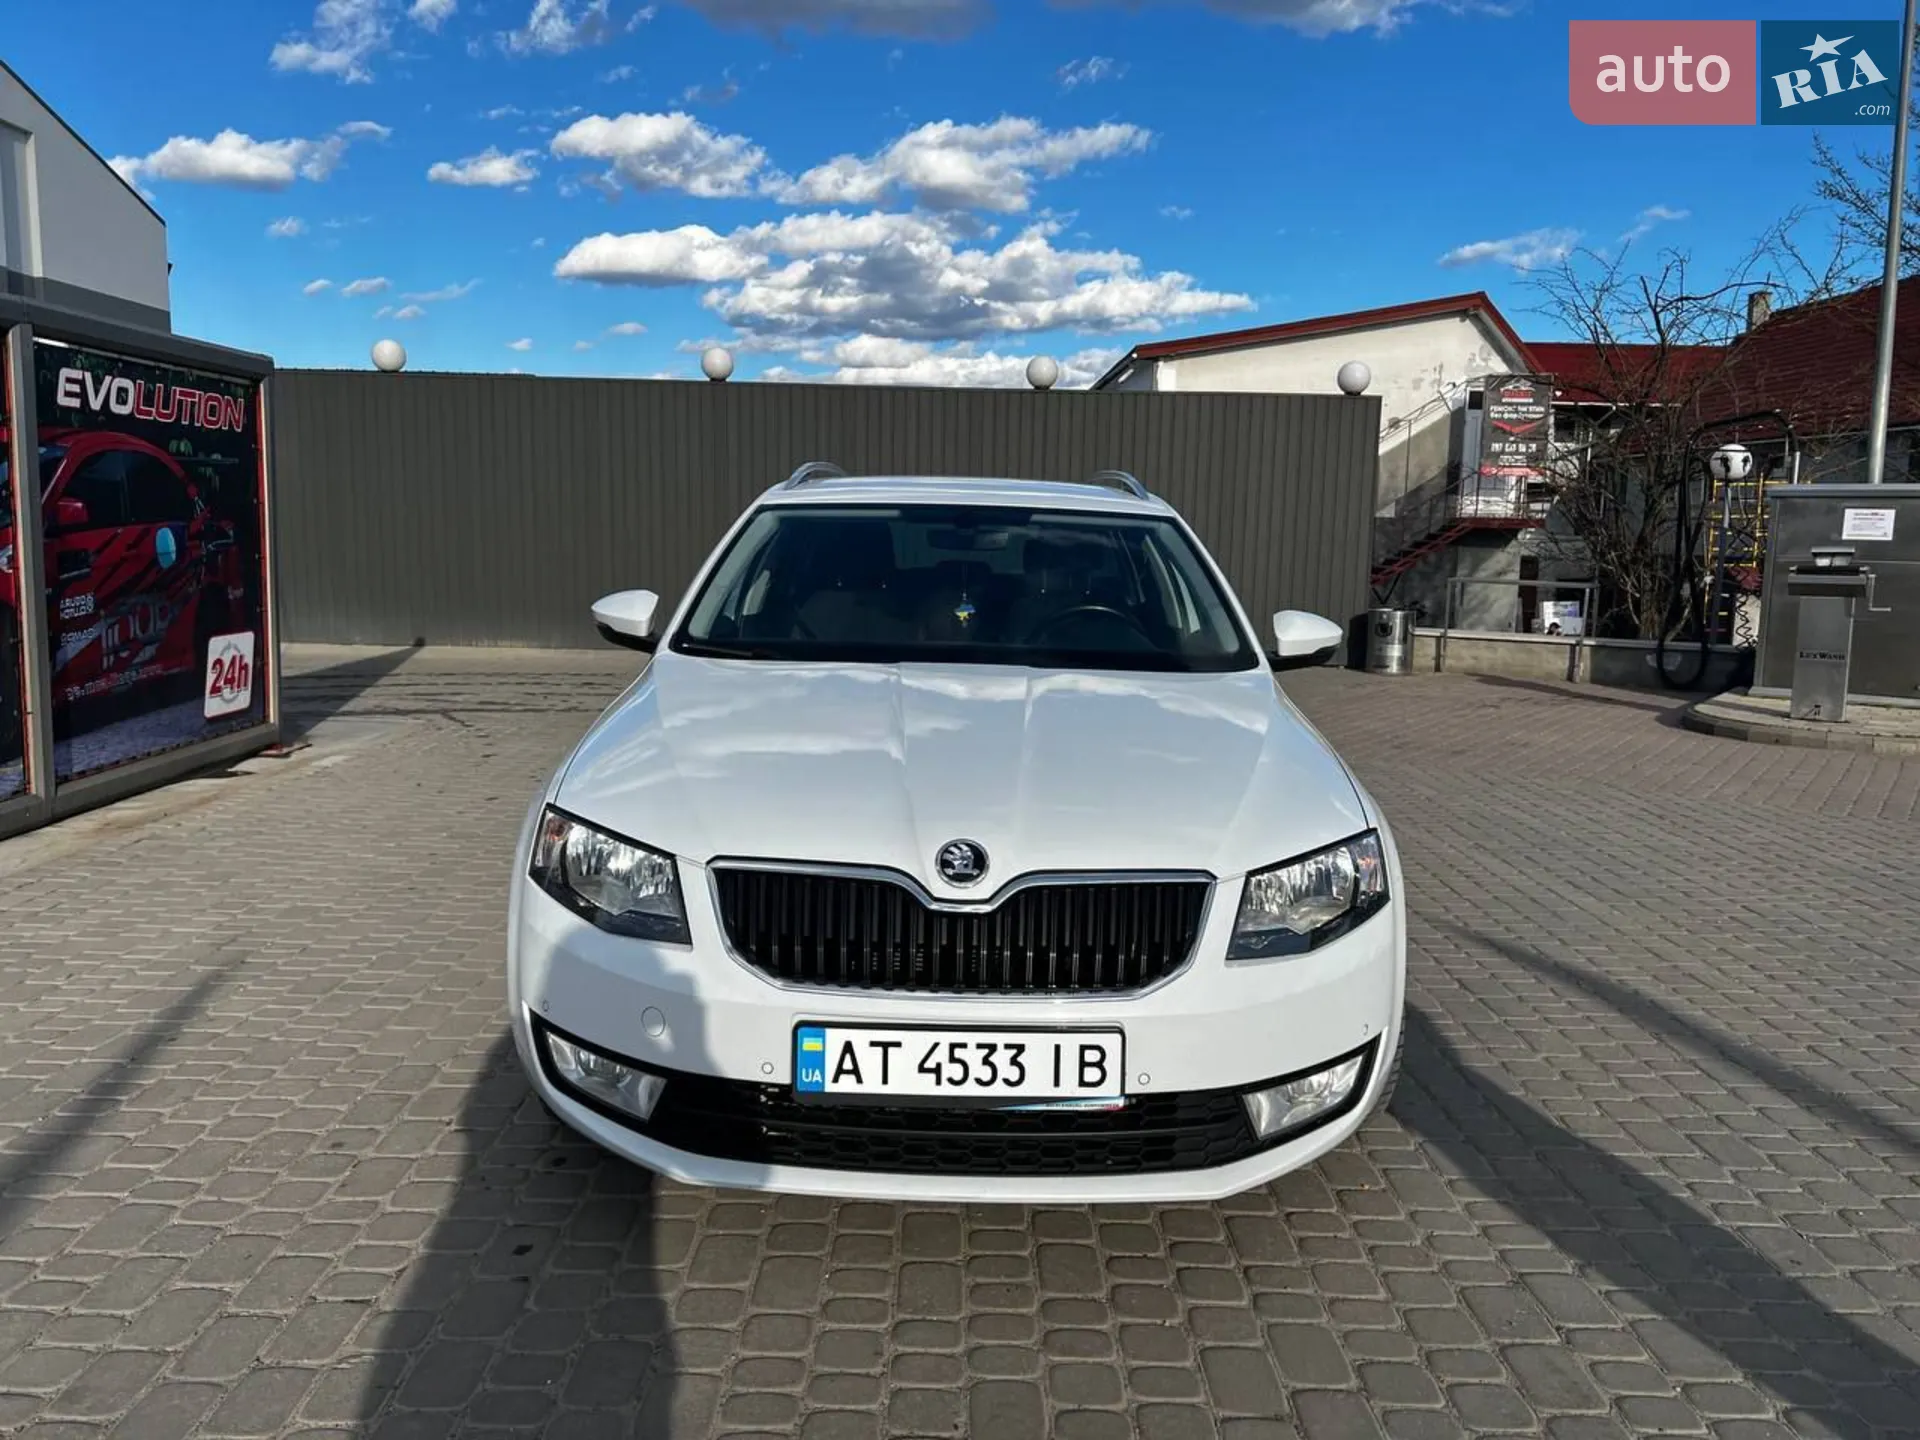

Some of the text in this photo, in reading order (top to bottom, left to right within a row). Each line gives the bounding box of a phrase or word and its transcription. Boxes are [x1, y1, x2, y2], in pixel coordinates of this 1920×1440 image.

[56, 366, 245, 432] EVOLUTION
[209, 653, 249, 696] 24h
[801, 1068, 823, 1083] UA
[831, 1040, 1107, 1088] AT 4533 IB
